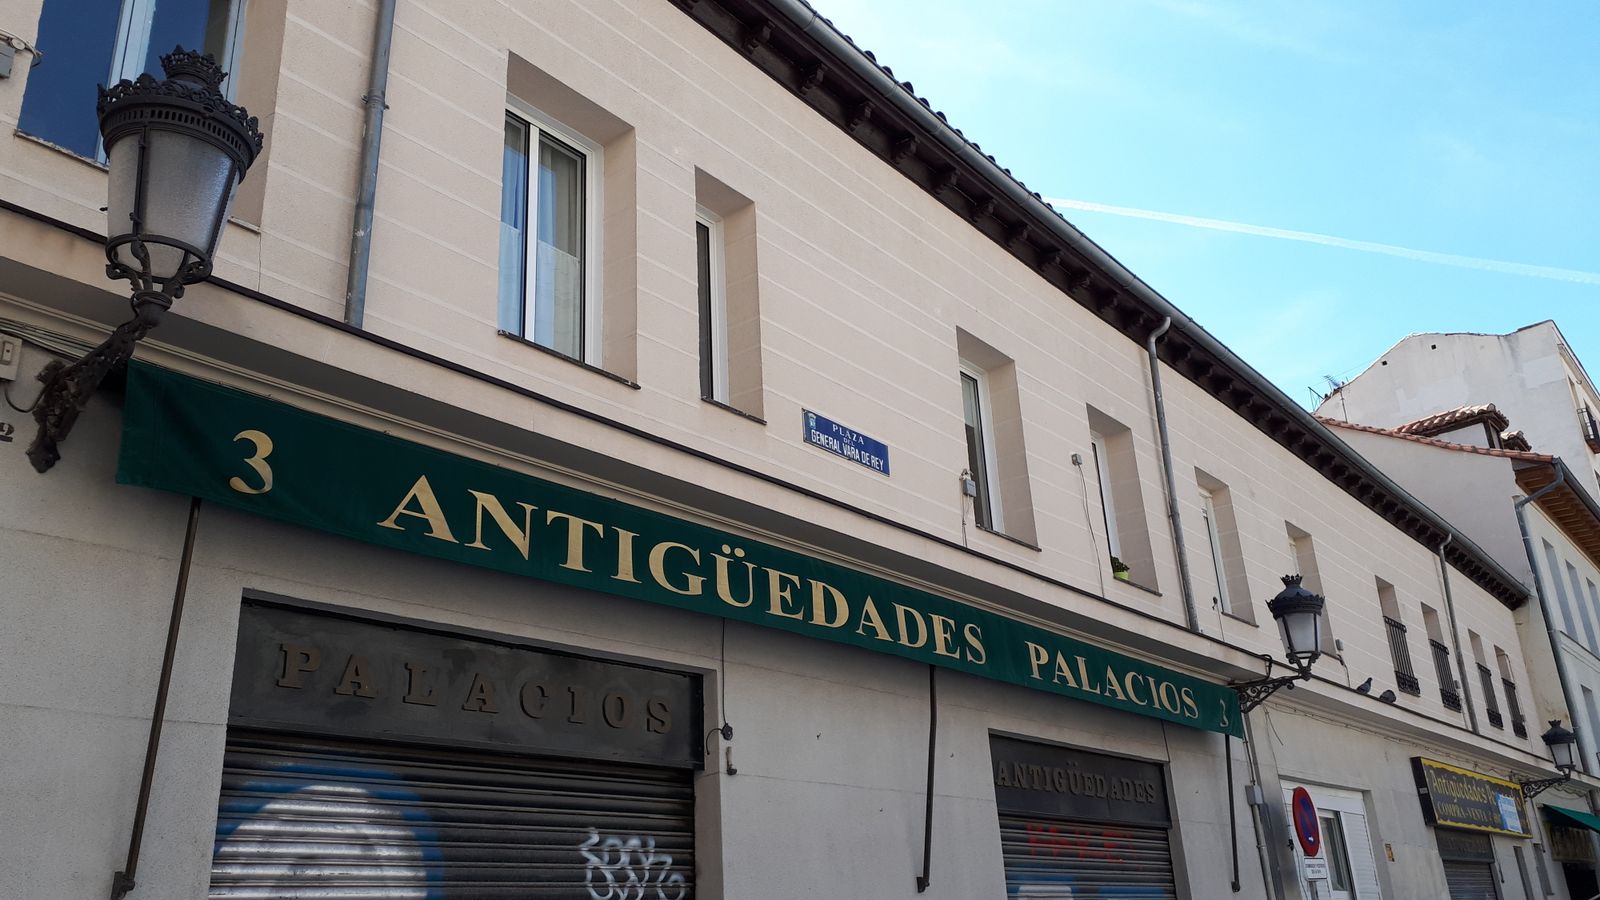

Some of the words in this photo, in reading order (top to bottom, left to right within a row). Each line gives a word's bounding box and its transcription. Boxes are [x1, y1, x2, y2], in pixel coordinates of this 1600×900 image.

[811, 430, 842, 454] GENERAL
[842, 443, 861, 462] VARA
[861, 451, 871, 466] DE
[871, 455, 884, 471] REY
[832, 424, 865, 445] PLAZA
[843, 437, 855, 447] DEL
[229, 429, 274, 495] 3
[377, 474, 987, 665] ANTIGÜEDADES
[1024, 640, 1199, 720] PALACIOS
[276, 642, 674, 734] PALACIOS
[996, 760, 1157, 805] ANTIGÜEDADES
